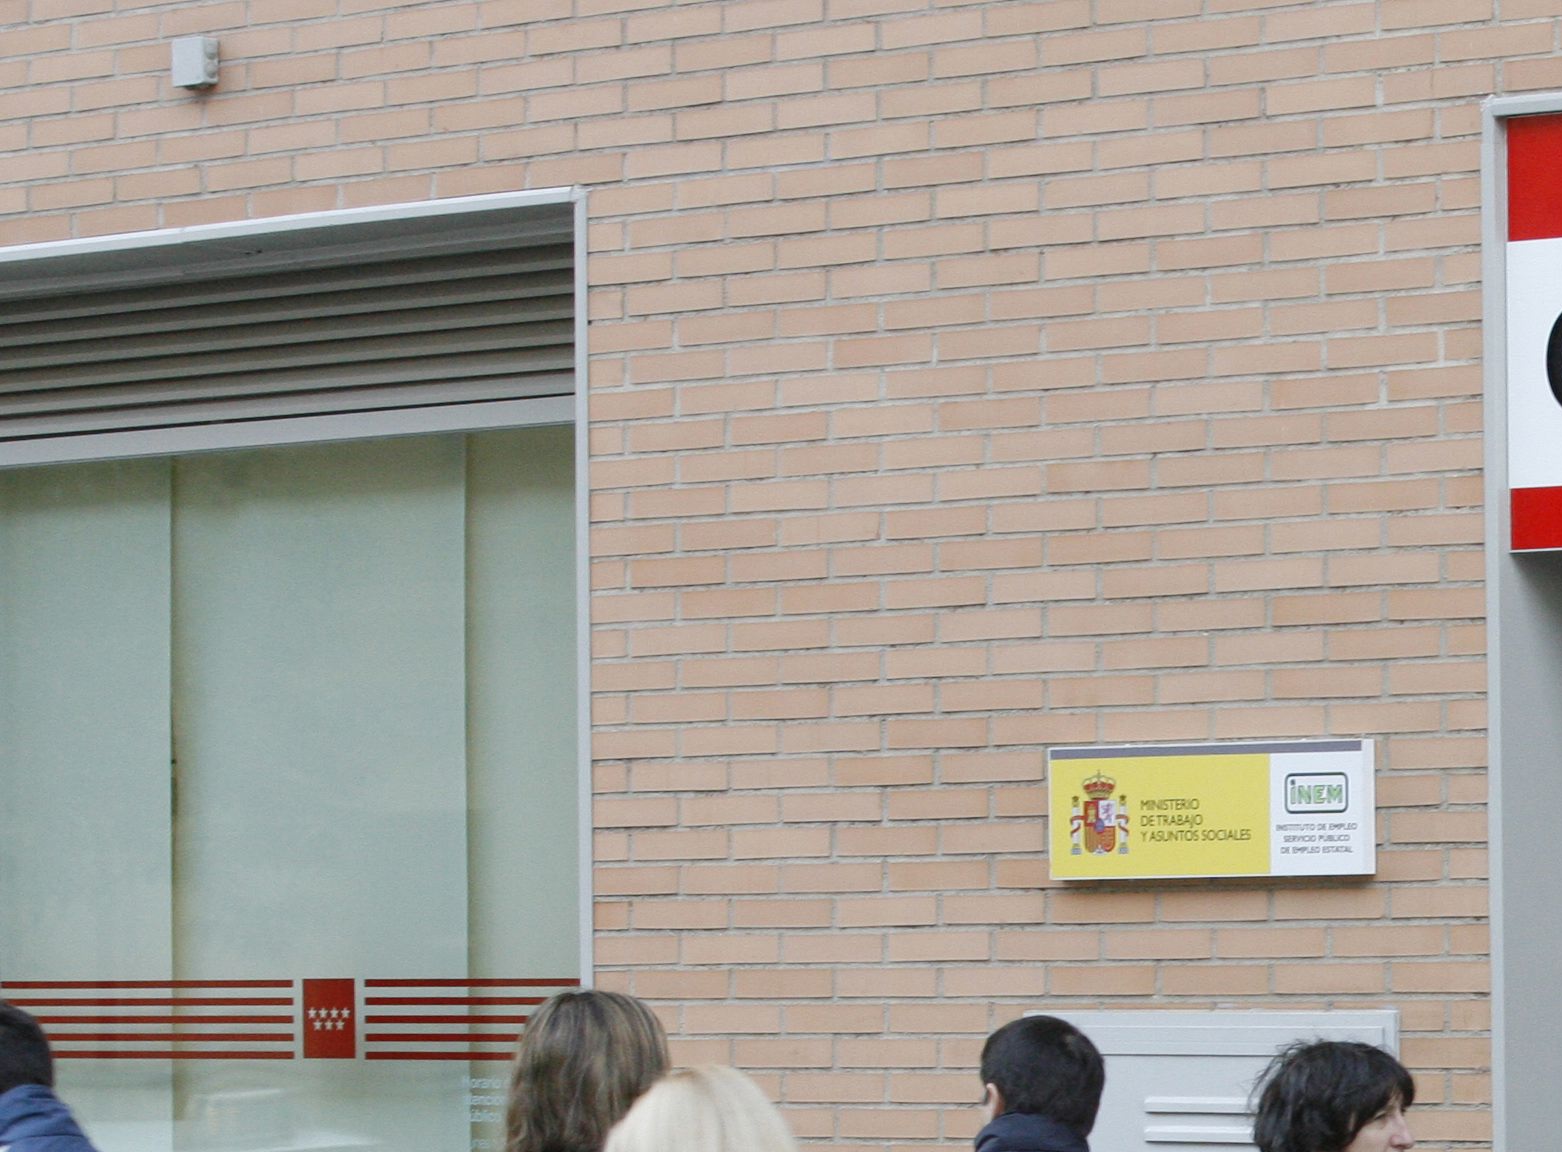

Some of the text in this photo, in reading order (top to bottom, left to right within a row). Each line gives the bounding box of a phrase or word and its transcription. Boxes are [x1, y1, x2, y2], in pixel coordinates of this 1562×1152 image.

[1140, 798, 1200, 811] MINISTERIO
[1140, 814, 1204, 829] DE TRABAJO
[1275, 822, 1358, 832] INSTITUTO DE EMPLEO
[1140, 828, 1252, 842] Y ASUNTOS SOCIALES
[1283, 834, 1317, 843] SERVICIO
[1280, 846, 1290, 855] DE
[1291, 845, 1321, 854] EMPLEO
